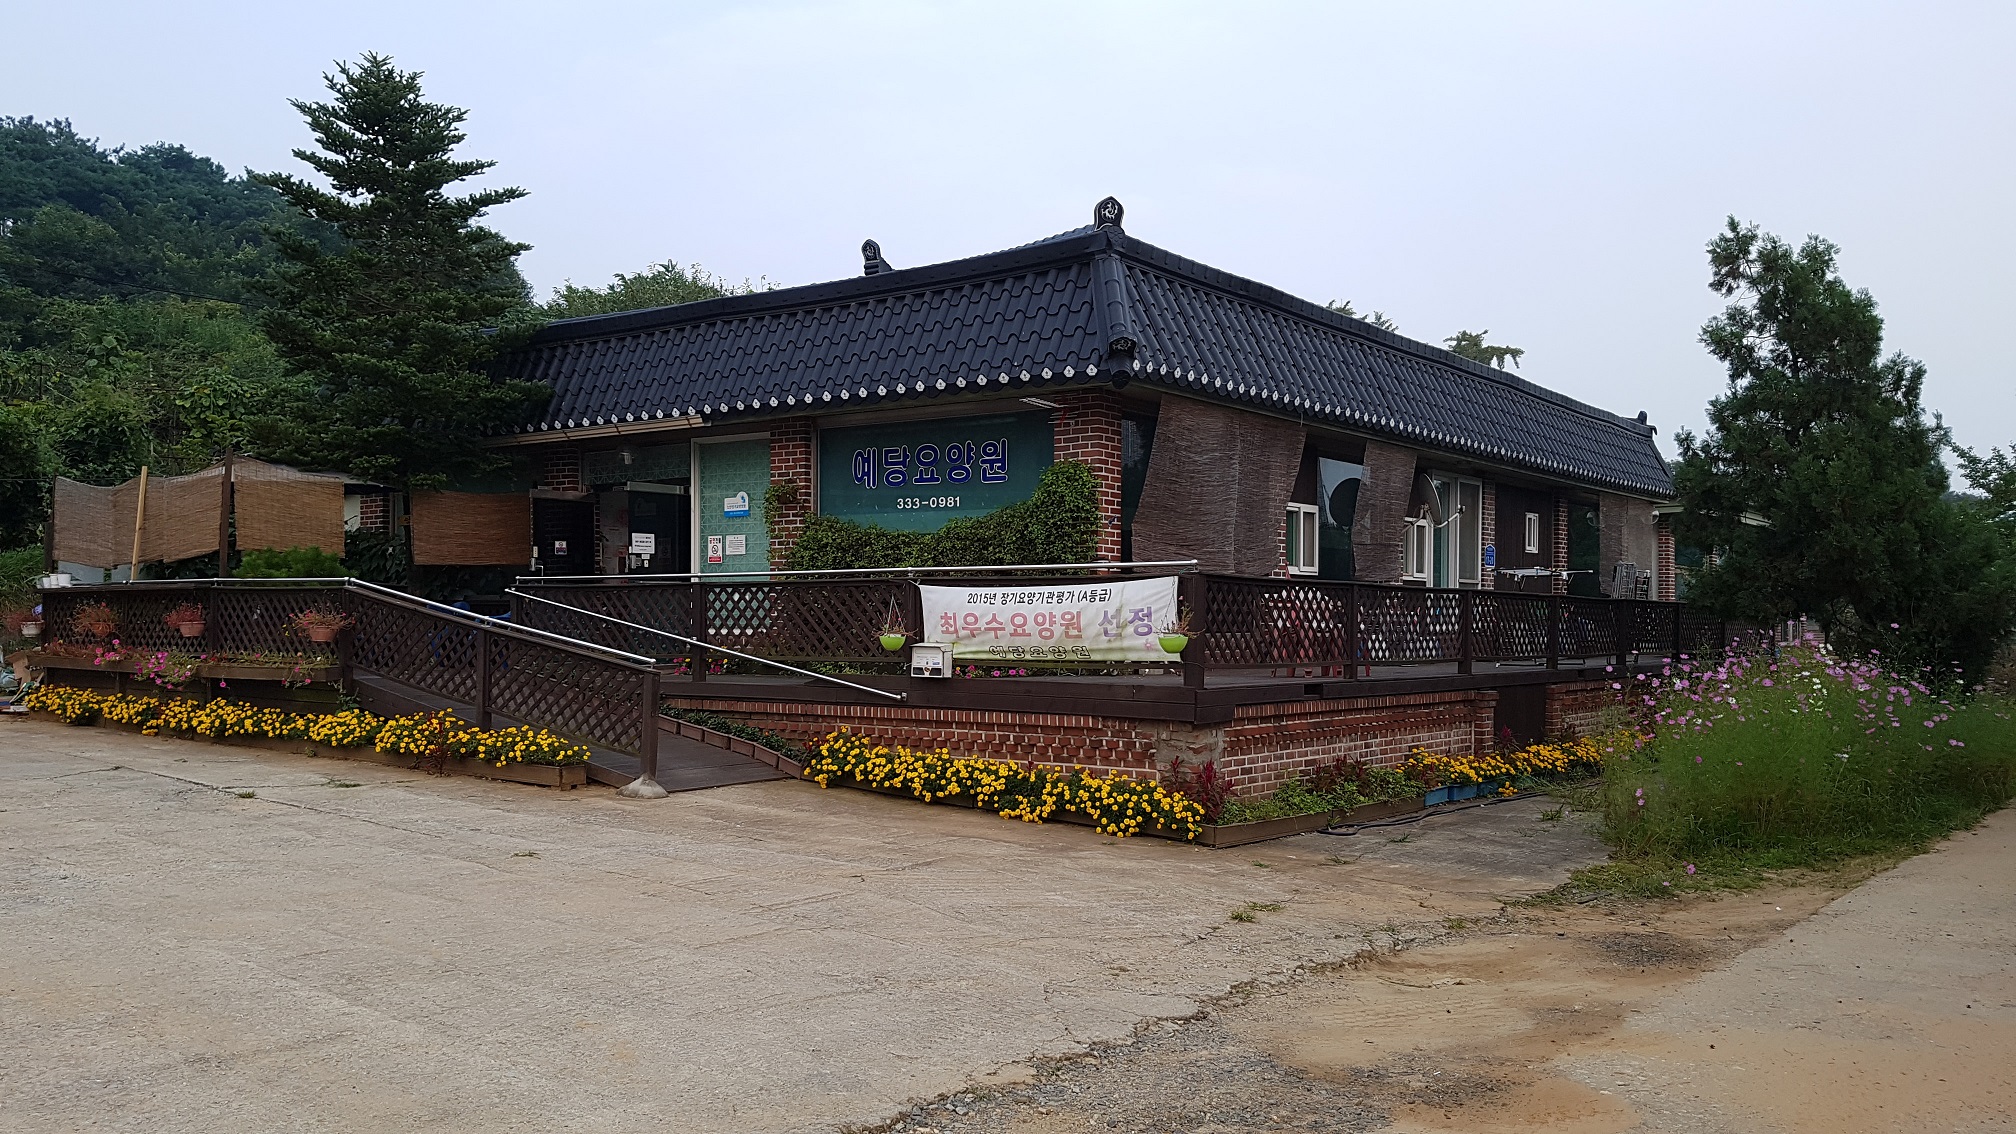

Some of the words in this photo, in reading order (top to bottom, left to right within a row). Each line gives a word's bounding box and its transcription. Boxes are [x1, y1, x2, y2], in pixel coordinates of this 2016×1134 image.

[852, 437, 1008, 489] 예당요양원
[896, 496, 961, 509] 333-0981
[967, 592, 997, 605] 2015년
[1000, 590, 1075, 606] 장기요양기관평가
[1077, 588, 1112, 604] (A등급)
[940, 610, 1083, 640] 최우수요양원
[1098, 606, 1154, 638] 선정
